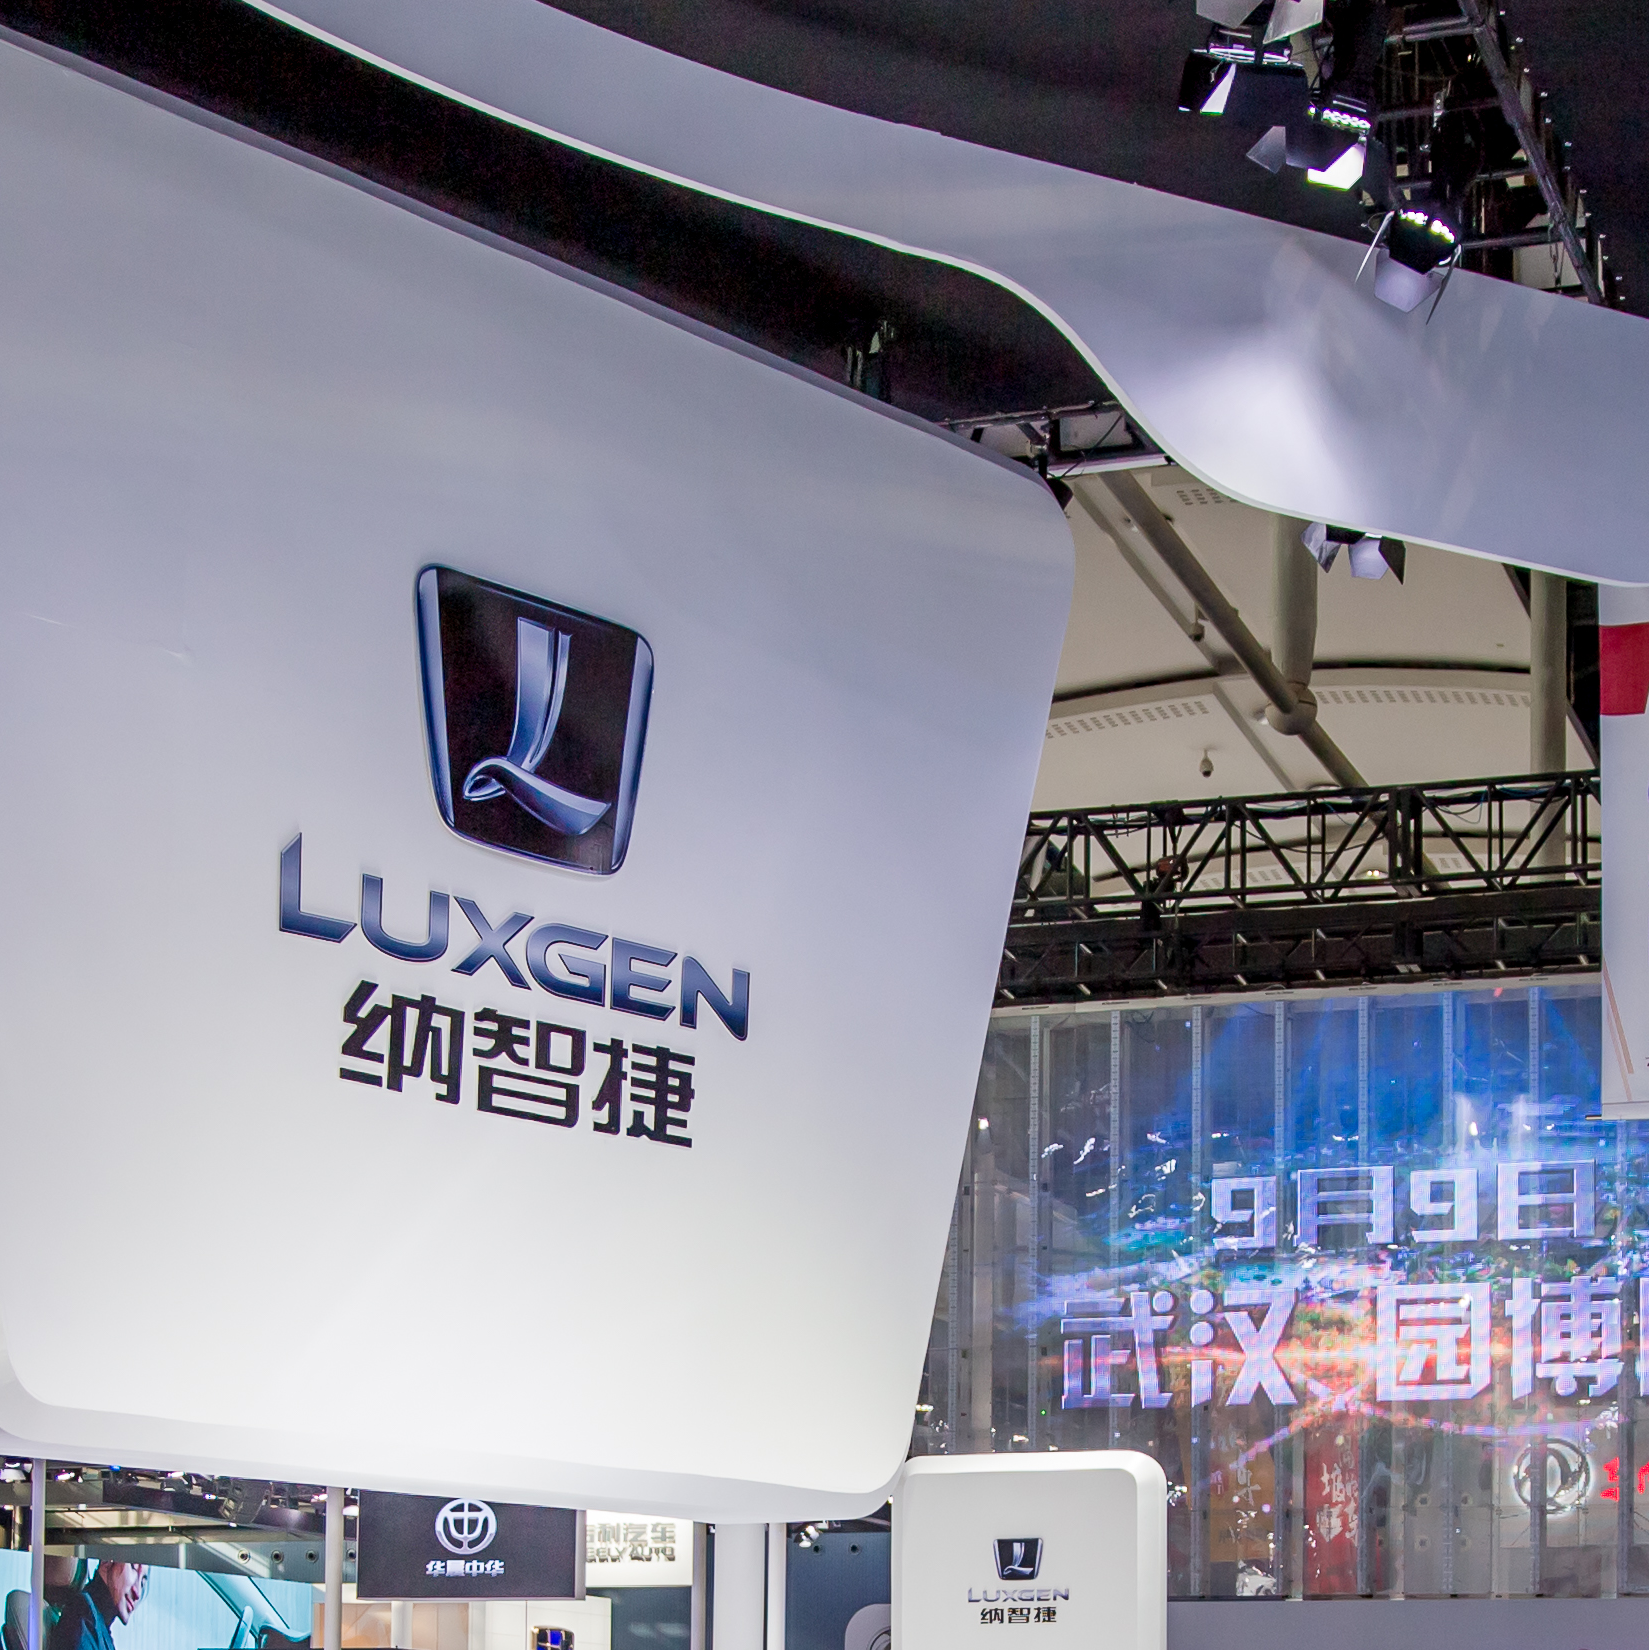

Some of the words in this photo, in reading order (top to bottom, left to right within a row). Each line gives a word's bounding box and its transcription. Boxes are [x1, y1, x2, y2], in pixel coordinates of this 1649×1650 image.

[278, 831, 750, 1042] LUXGEN
[338, 979, 696, 1148] 纳智捷
[1210, 1160, 1598, 1250] 9月9日
[1060, 1287, 1299, 1409] 武汉
[967, 1587, 1070, 1603] LUXGEN
[980, 1606, 1057, 1625] 纳智捷
